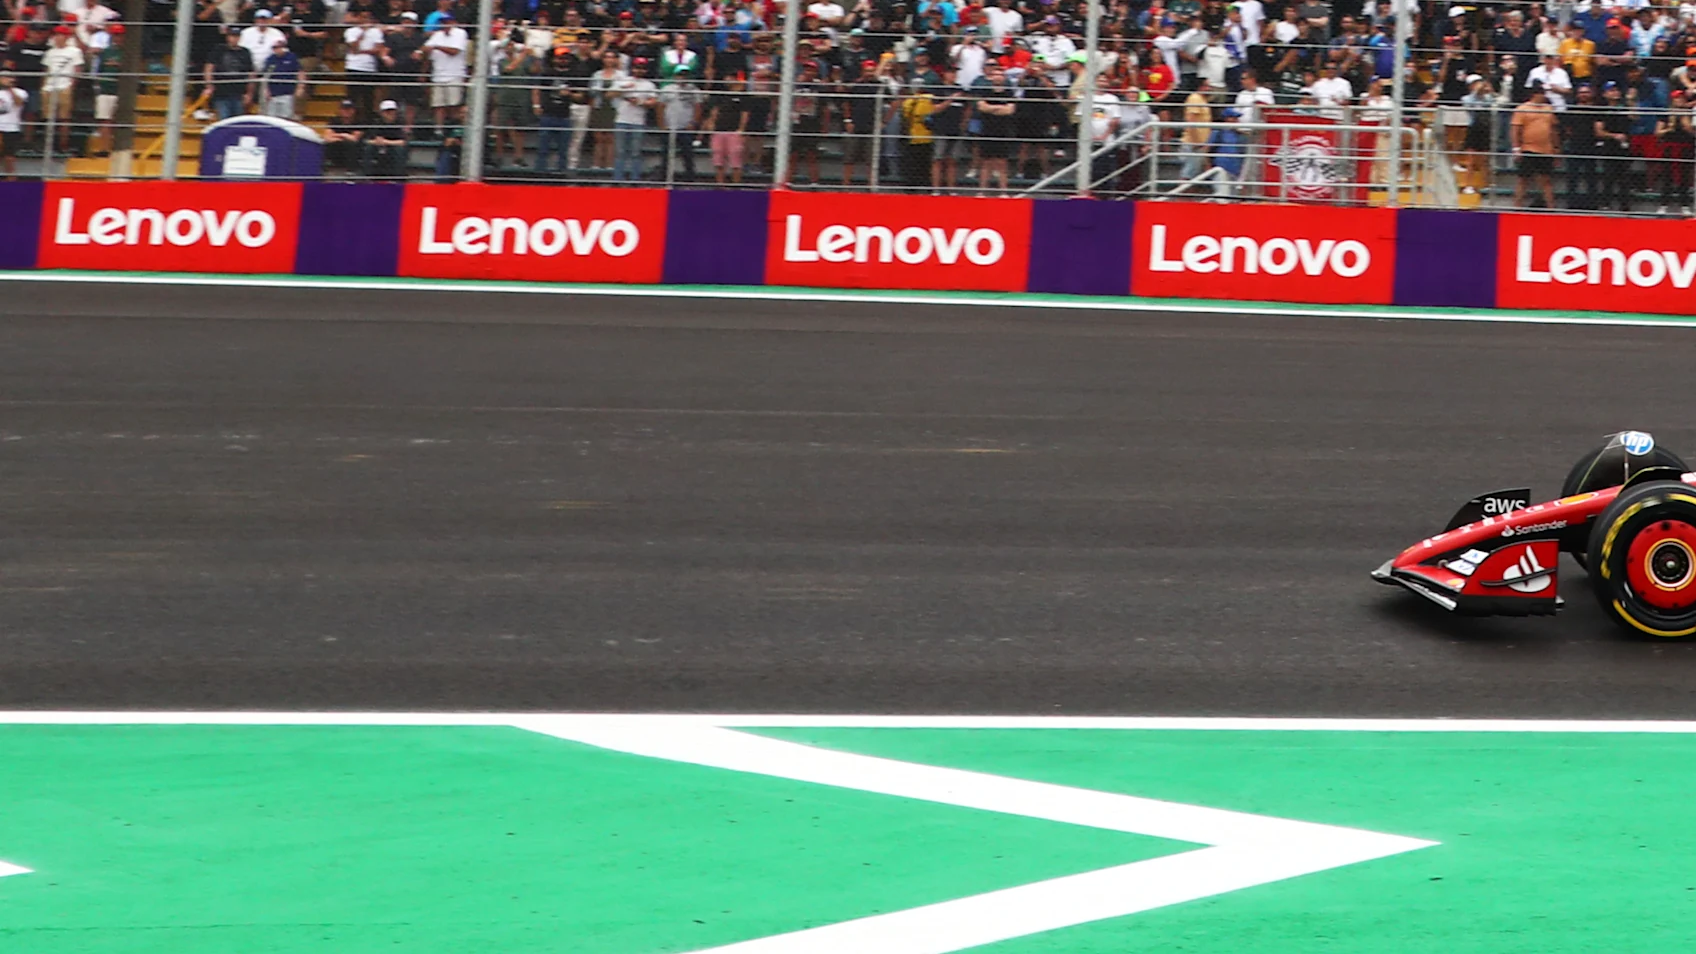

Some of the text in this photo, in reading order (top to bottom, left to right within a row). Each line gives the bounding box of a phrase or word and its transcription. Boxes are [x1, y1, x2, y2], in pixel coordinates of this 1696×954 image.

[55, 197, 275, 248] Lenovo
[418, 206, 639, 257] Lenovo
[784, 214, 1005, 265] Lenovo
[1149, 224, 1370, 277] Lenovo
[1515, 520, 1568, 536] Santander
